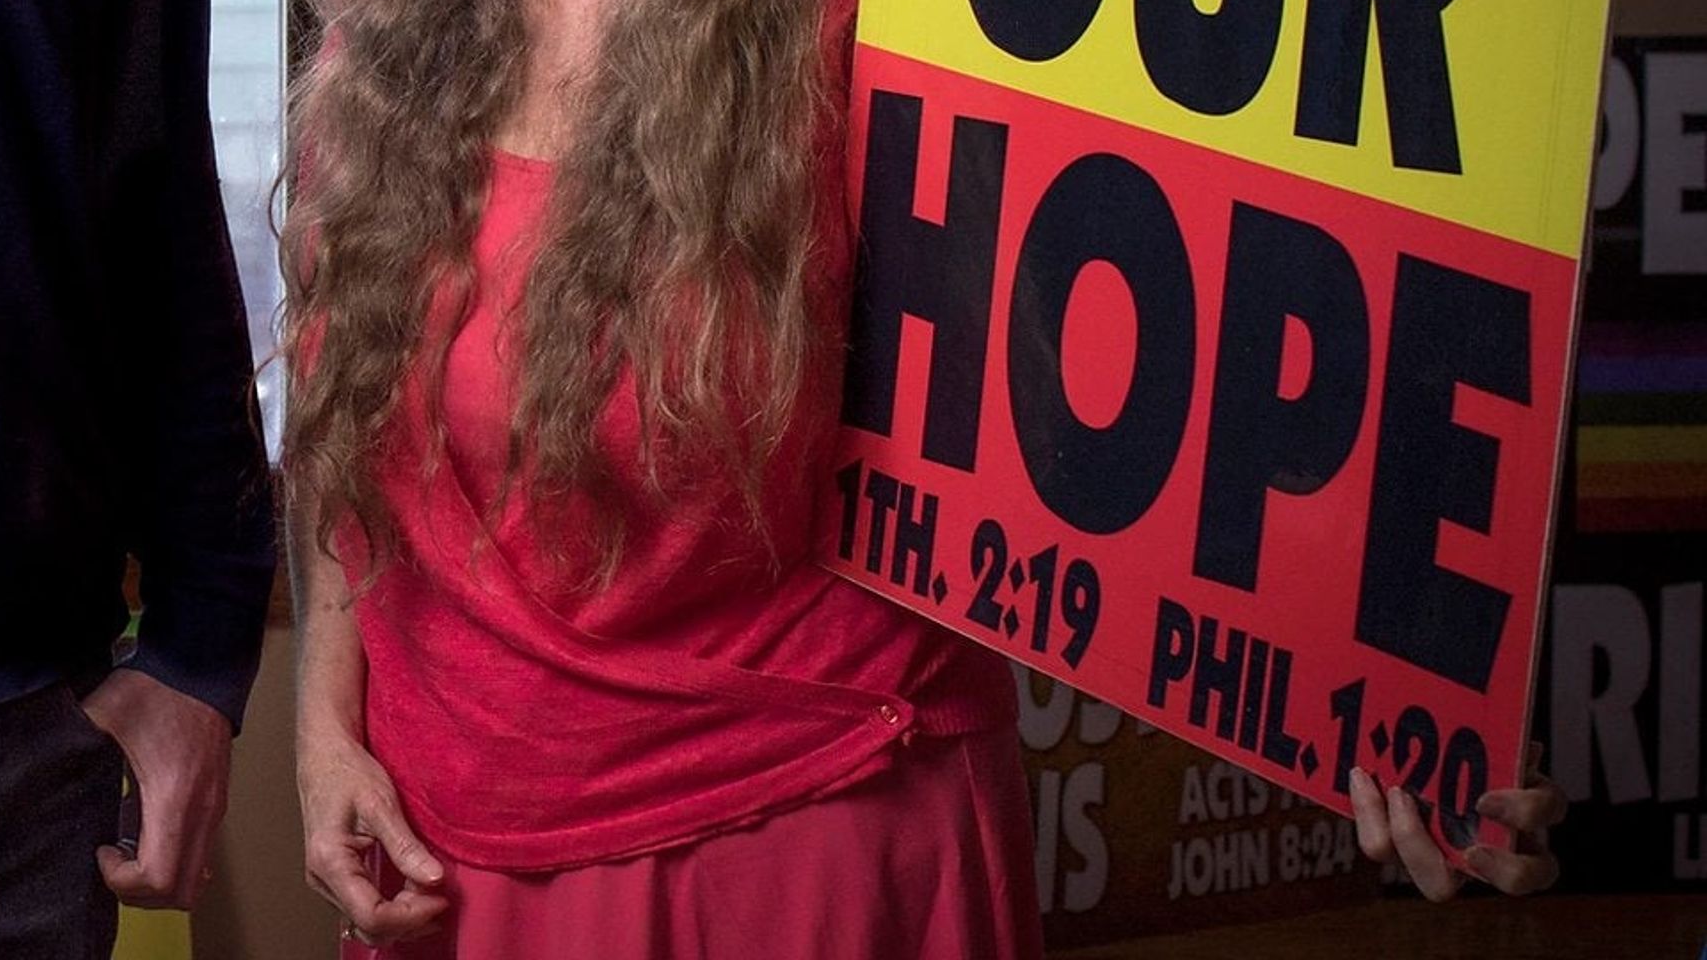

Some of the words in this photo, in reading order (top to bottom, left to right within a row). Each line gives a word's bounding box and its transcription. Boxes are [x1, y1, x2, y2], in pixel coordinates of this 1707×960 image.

[841, 88, 1531, 694] HOPE
[836, 457, 948, 606] 1TH.
[965, 518, 1101, 668] 2:19
[1147, 596, 1319, 780] PHIL.
[1167, 829, 1271, 901] JOHN
[1278, 818, 1354, 882] 8:24
[1178, 761, 1270, 825] ACTS
